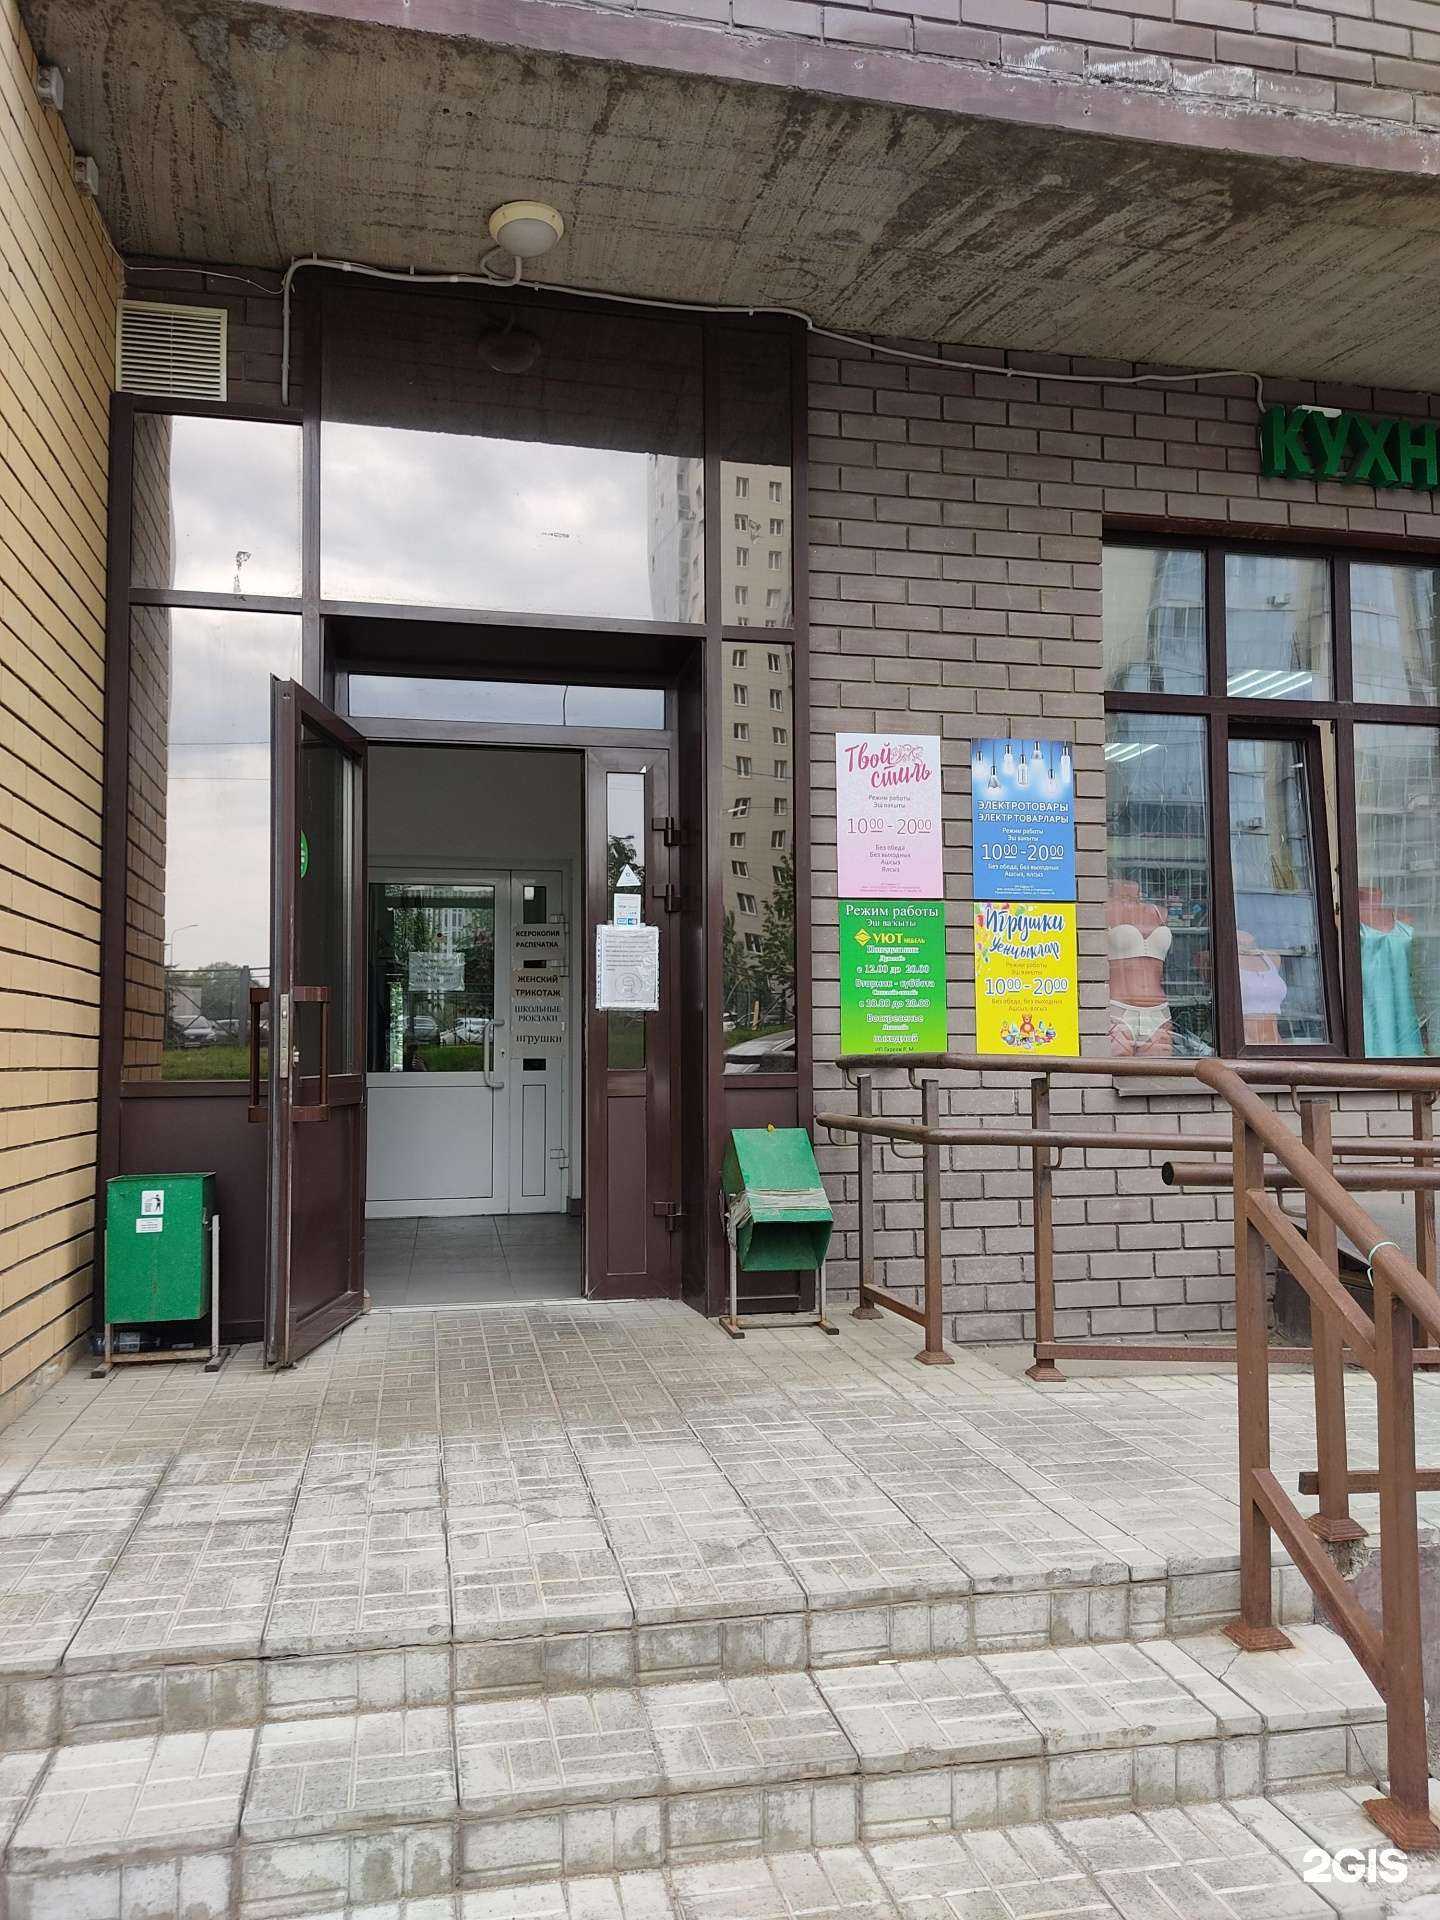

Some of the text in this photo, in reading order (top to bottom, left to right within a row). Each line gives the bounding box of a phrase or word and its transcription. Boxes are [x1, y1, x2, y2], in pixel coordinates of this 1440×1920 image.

[1264, 404, 1438, 488] КУХН
[845, 742, 891, 772] Твой
[871, 762, 932, 788] стиль
[978, 801, 1069, 812] ЭЛЕКТРОТОВАРЫ
[978, 813, 1069, 824] ЭЛЕКТР ТОВАРЛАРЫ
[1023, 828, 1044, 836] работы
[845, 905, 938, 919] Режим работы
[866, 919, 880, 927] Эш
[986, 908, 1064, 942] Игрушки
[872, 932, 903, 944] УЮТ
[517, 974, 559, 983] ЖЕНСКИЙ
[515, 989, 561, 997] ТРИКОТАЖ
[514, 1005, 561, 1013] ШКОЛЬНЫЕ
